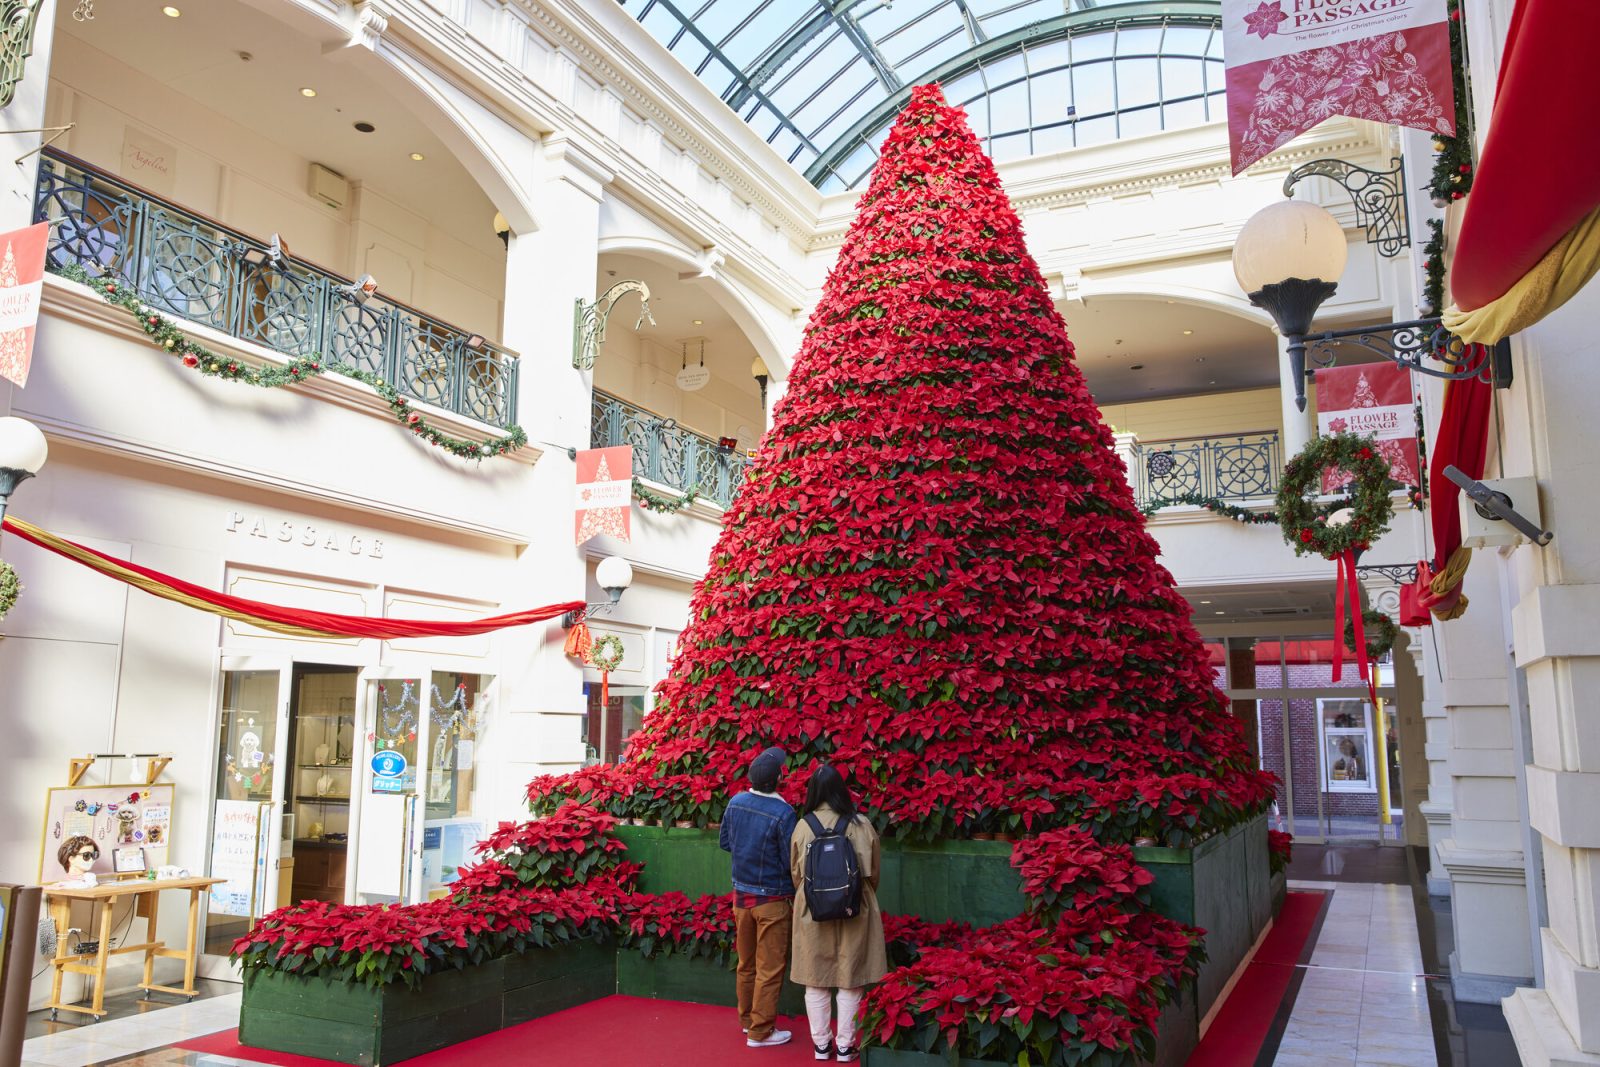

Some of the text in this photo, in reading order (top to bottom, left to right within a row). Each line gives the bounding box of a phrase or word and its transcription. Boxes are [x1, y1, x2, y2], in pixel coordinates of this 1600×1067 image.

[1294, 0, 1406, 27] PASSAGE
[1308, 31, 1329, 39] flower
[1351, 19, 1385, 30] Christmas
[1386, 13, 1408, 22] colors
[1350, 412, 1398, 424] FLOWER
[1351, 421, 1399, 431] PASSAGE
[226, 511, 383, 559] PASSAGE
